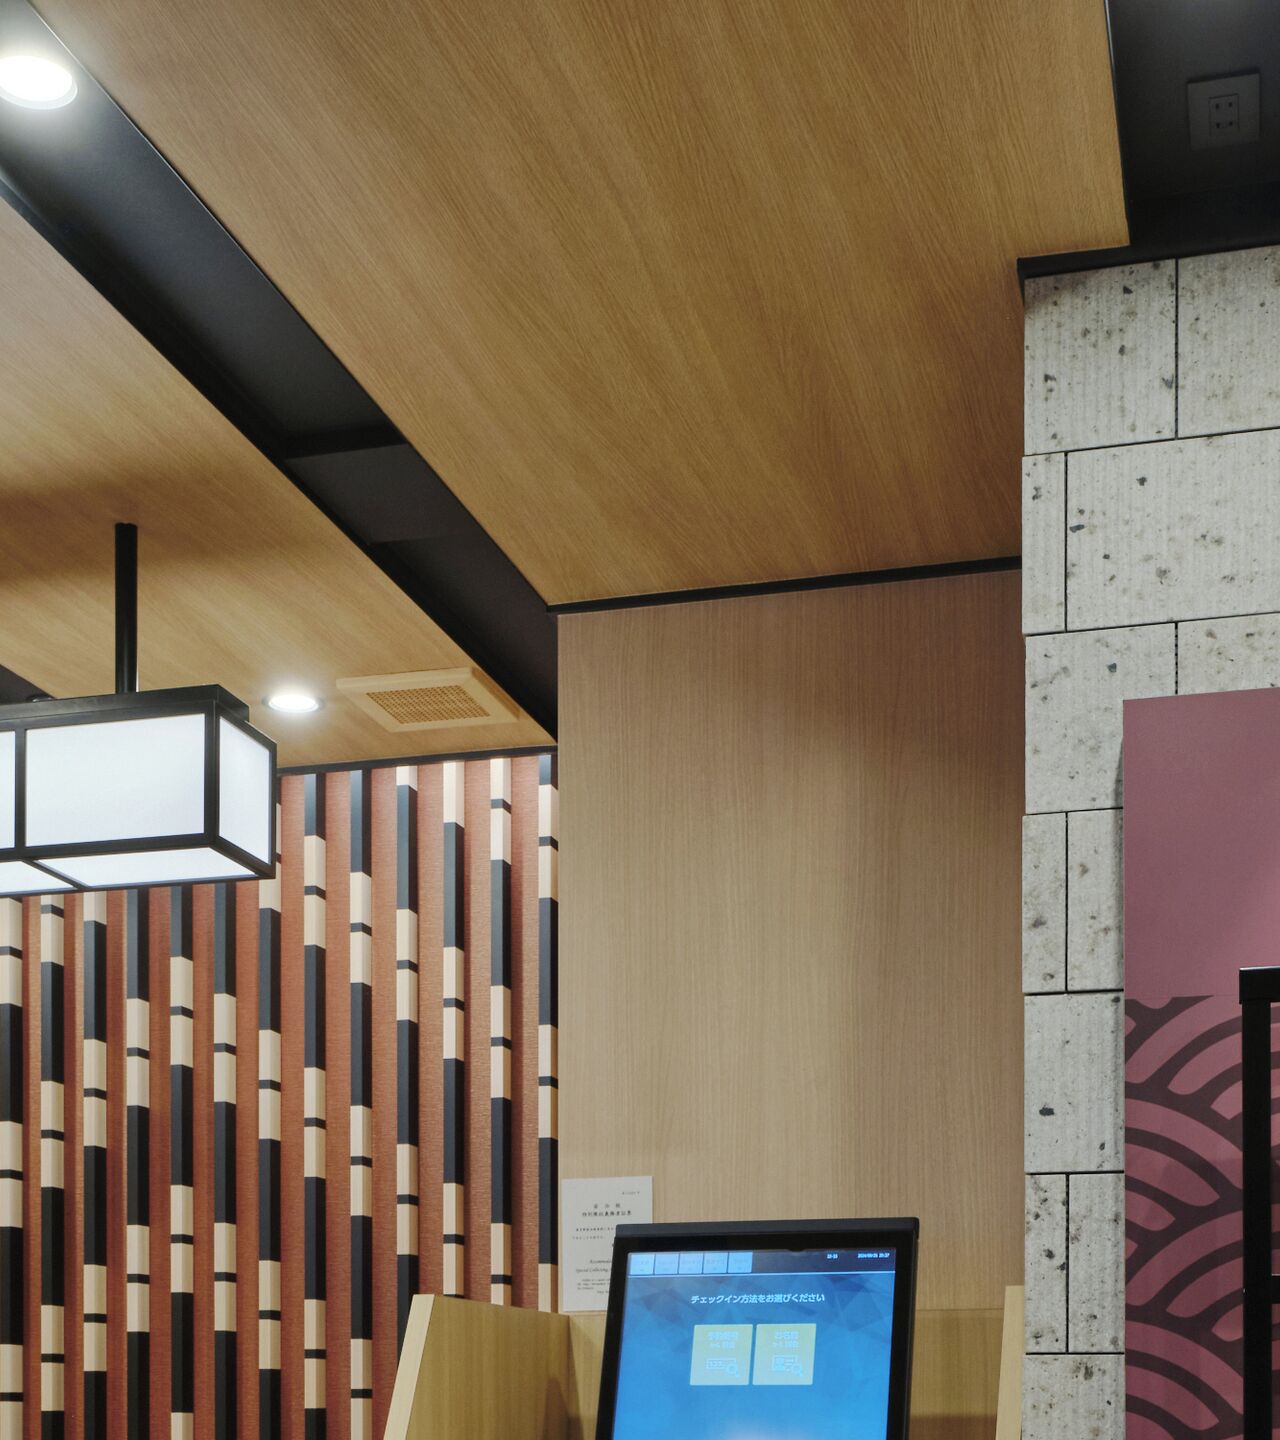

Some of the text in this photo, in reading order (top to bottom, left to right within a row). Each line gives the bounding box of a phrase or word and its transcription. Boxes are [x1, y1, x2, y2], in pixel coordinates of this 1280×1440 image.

[690, 1293, 825, 1304] チェックイン方法をお選びください
